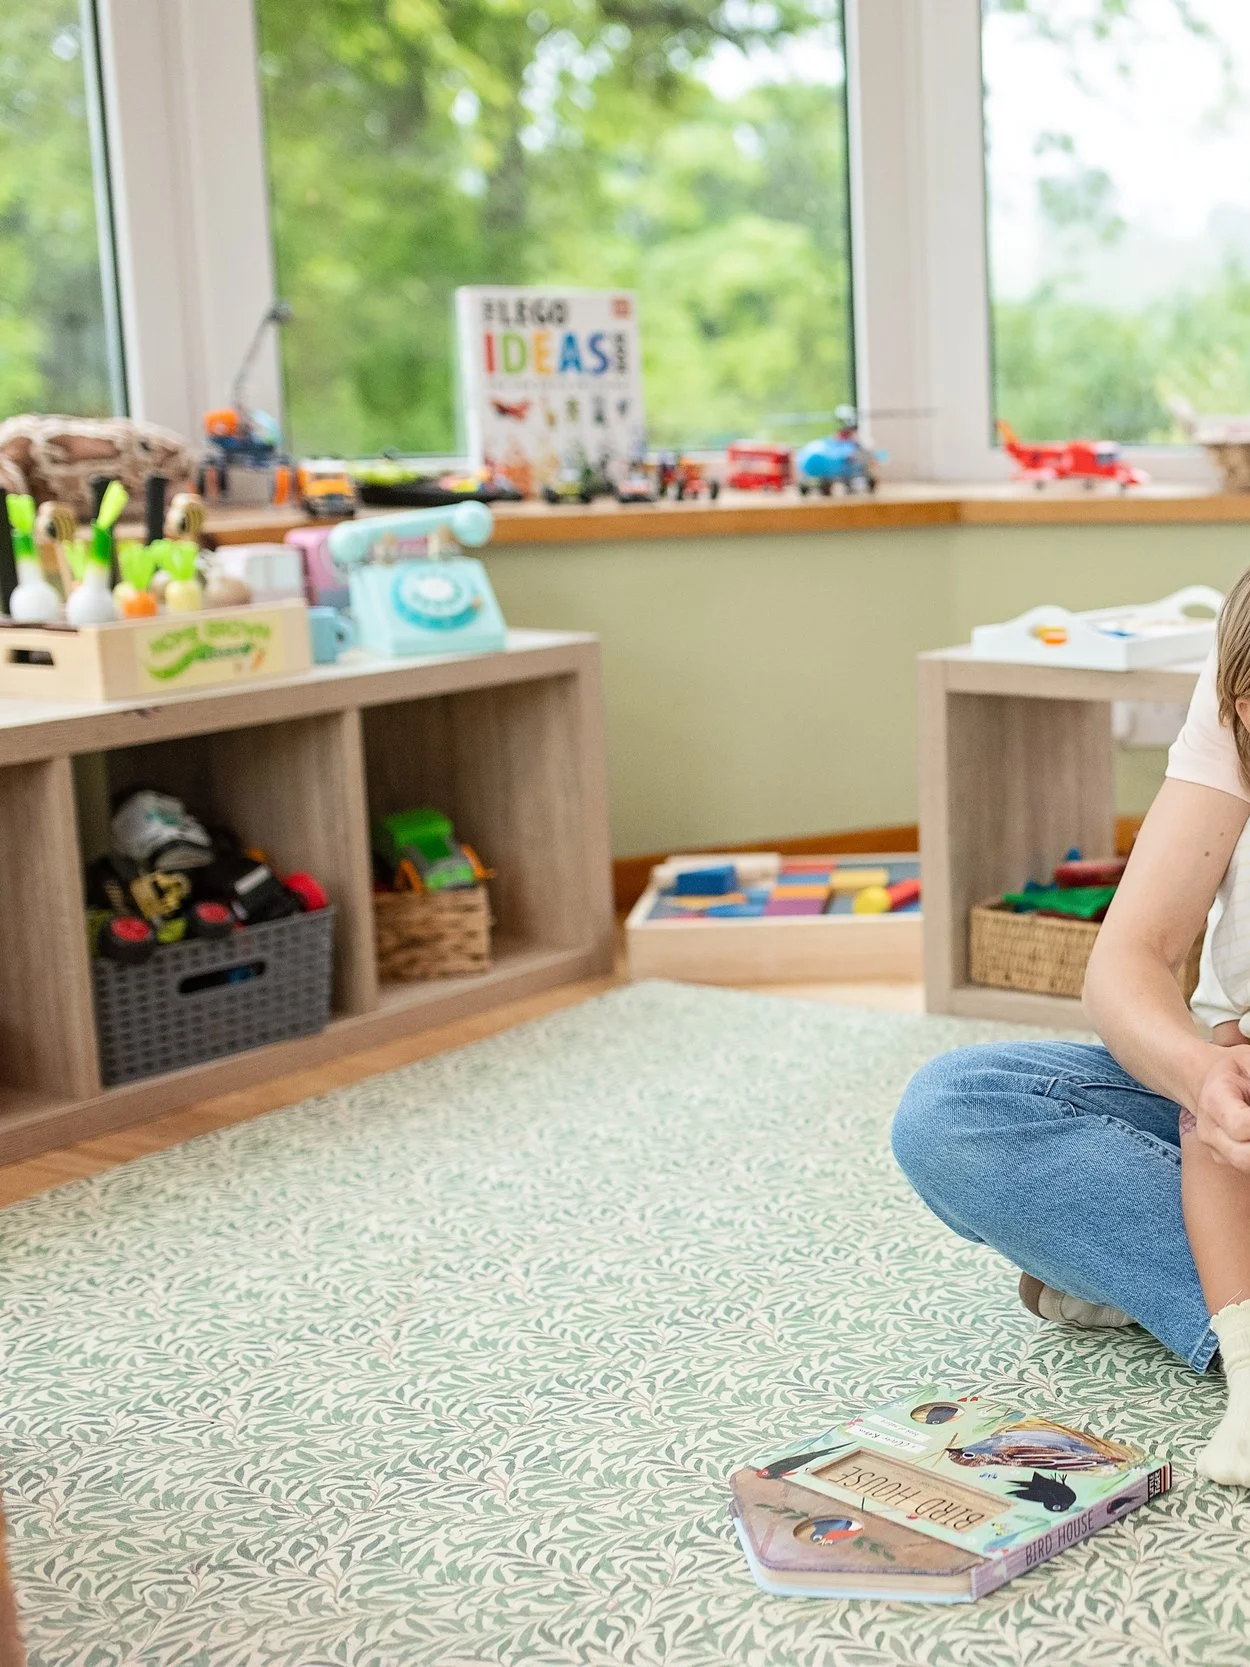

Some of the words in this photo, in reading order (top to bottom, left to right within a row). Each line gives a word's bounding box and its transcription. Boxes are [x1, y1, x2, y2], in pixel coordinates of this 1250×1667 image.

[484, 331, 609, 375] IDEAS
[828, 1466, 921, 1506] HOUSE
[914, 1498, 985, 1530] BIRD
[1025, 1535, 1053, 1566] BIRD
[1057, 1508, 1095, 1548] HOUSE
